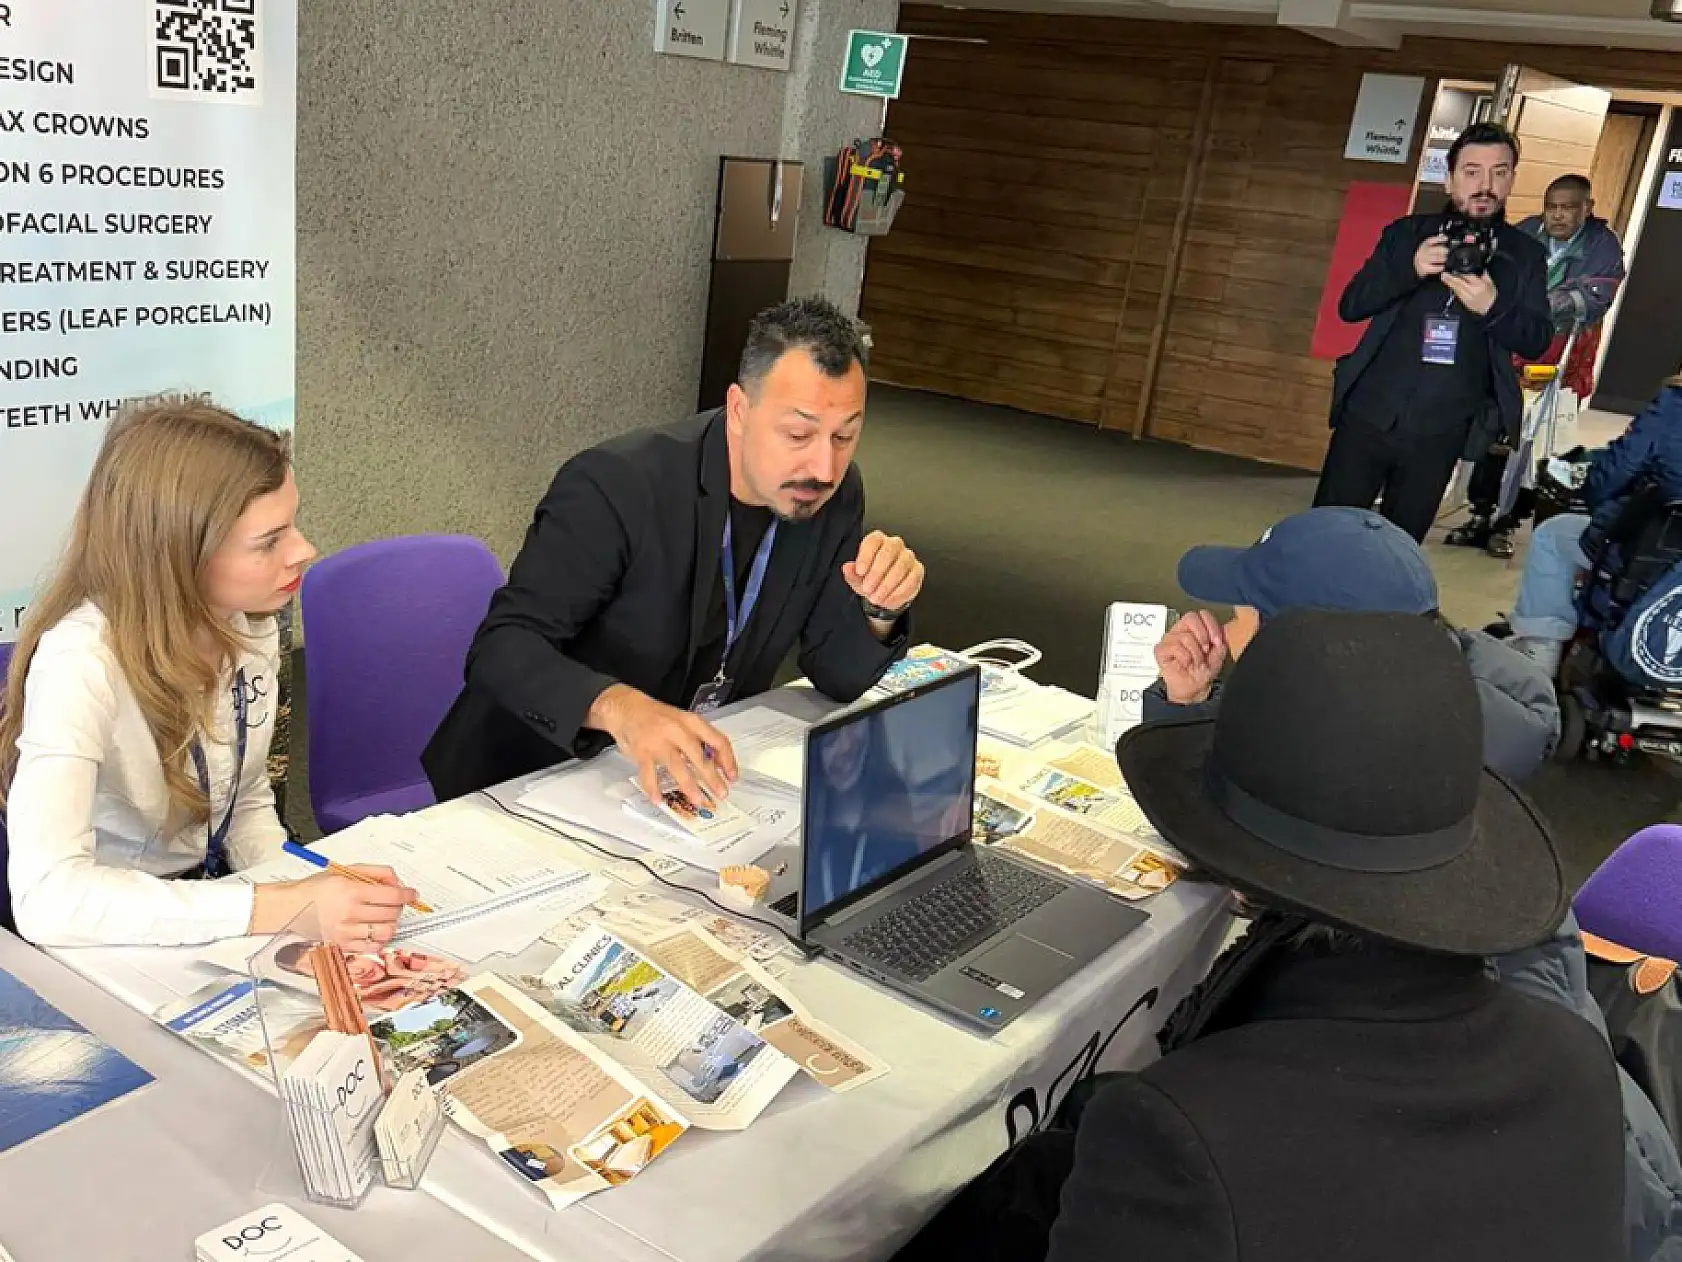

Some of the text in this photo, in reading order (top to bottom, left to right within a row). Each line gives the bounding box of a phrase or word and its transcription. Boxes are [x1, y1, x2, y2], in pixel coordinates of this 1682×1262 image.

[671, 27, 704, 46] Britten
[33, 112, 149, 138] CROWNS
[1366, 131, 1404, 146] Fleming
[39, 163, 54, 185] 6
[62, 164, 225, 189] PROCEDURES
[0, 212, 212, 235] FACIAL SURGERY
[0, 259, 269, 283] REATMENT & SURGERY
[3, 302, 271, 335] ERS (LEAF PORCELAIN)
[0, 402, 71, 427] EETH
[1123, 612, 1156, 627] DOC
[1120, 689, 1143, 703] DO
[572, 935, 611, 973] CLINICS
[337, 1059, 365, 1106] DOC
[222, 1216, 283, 1250] DOC
